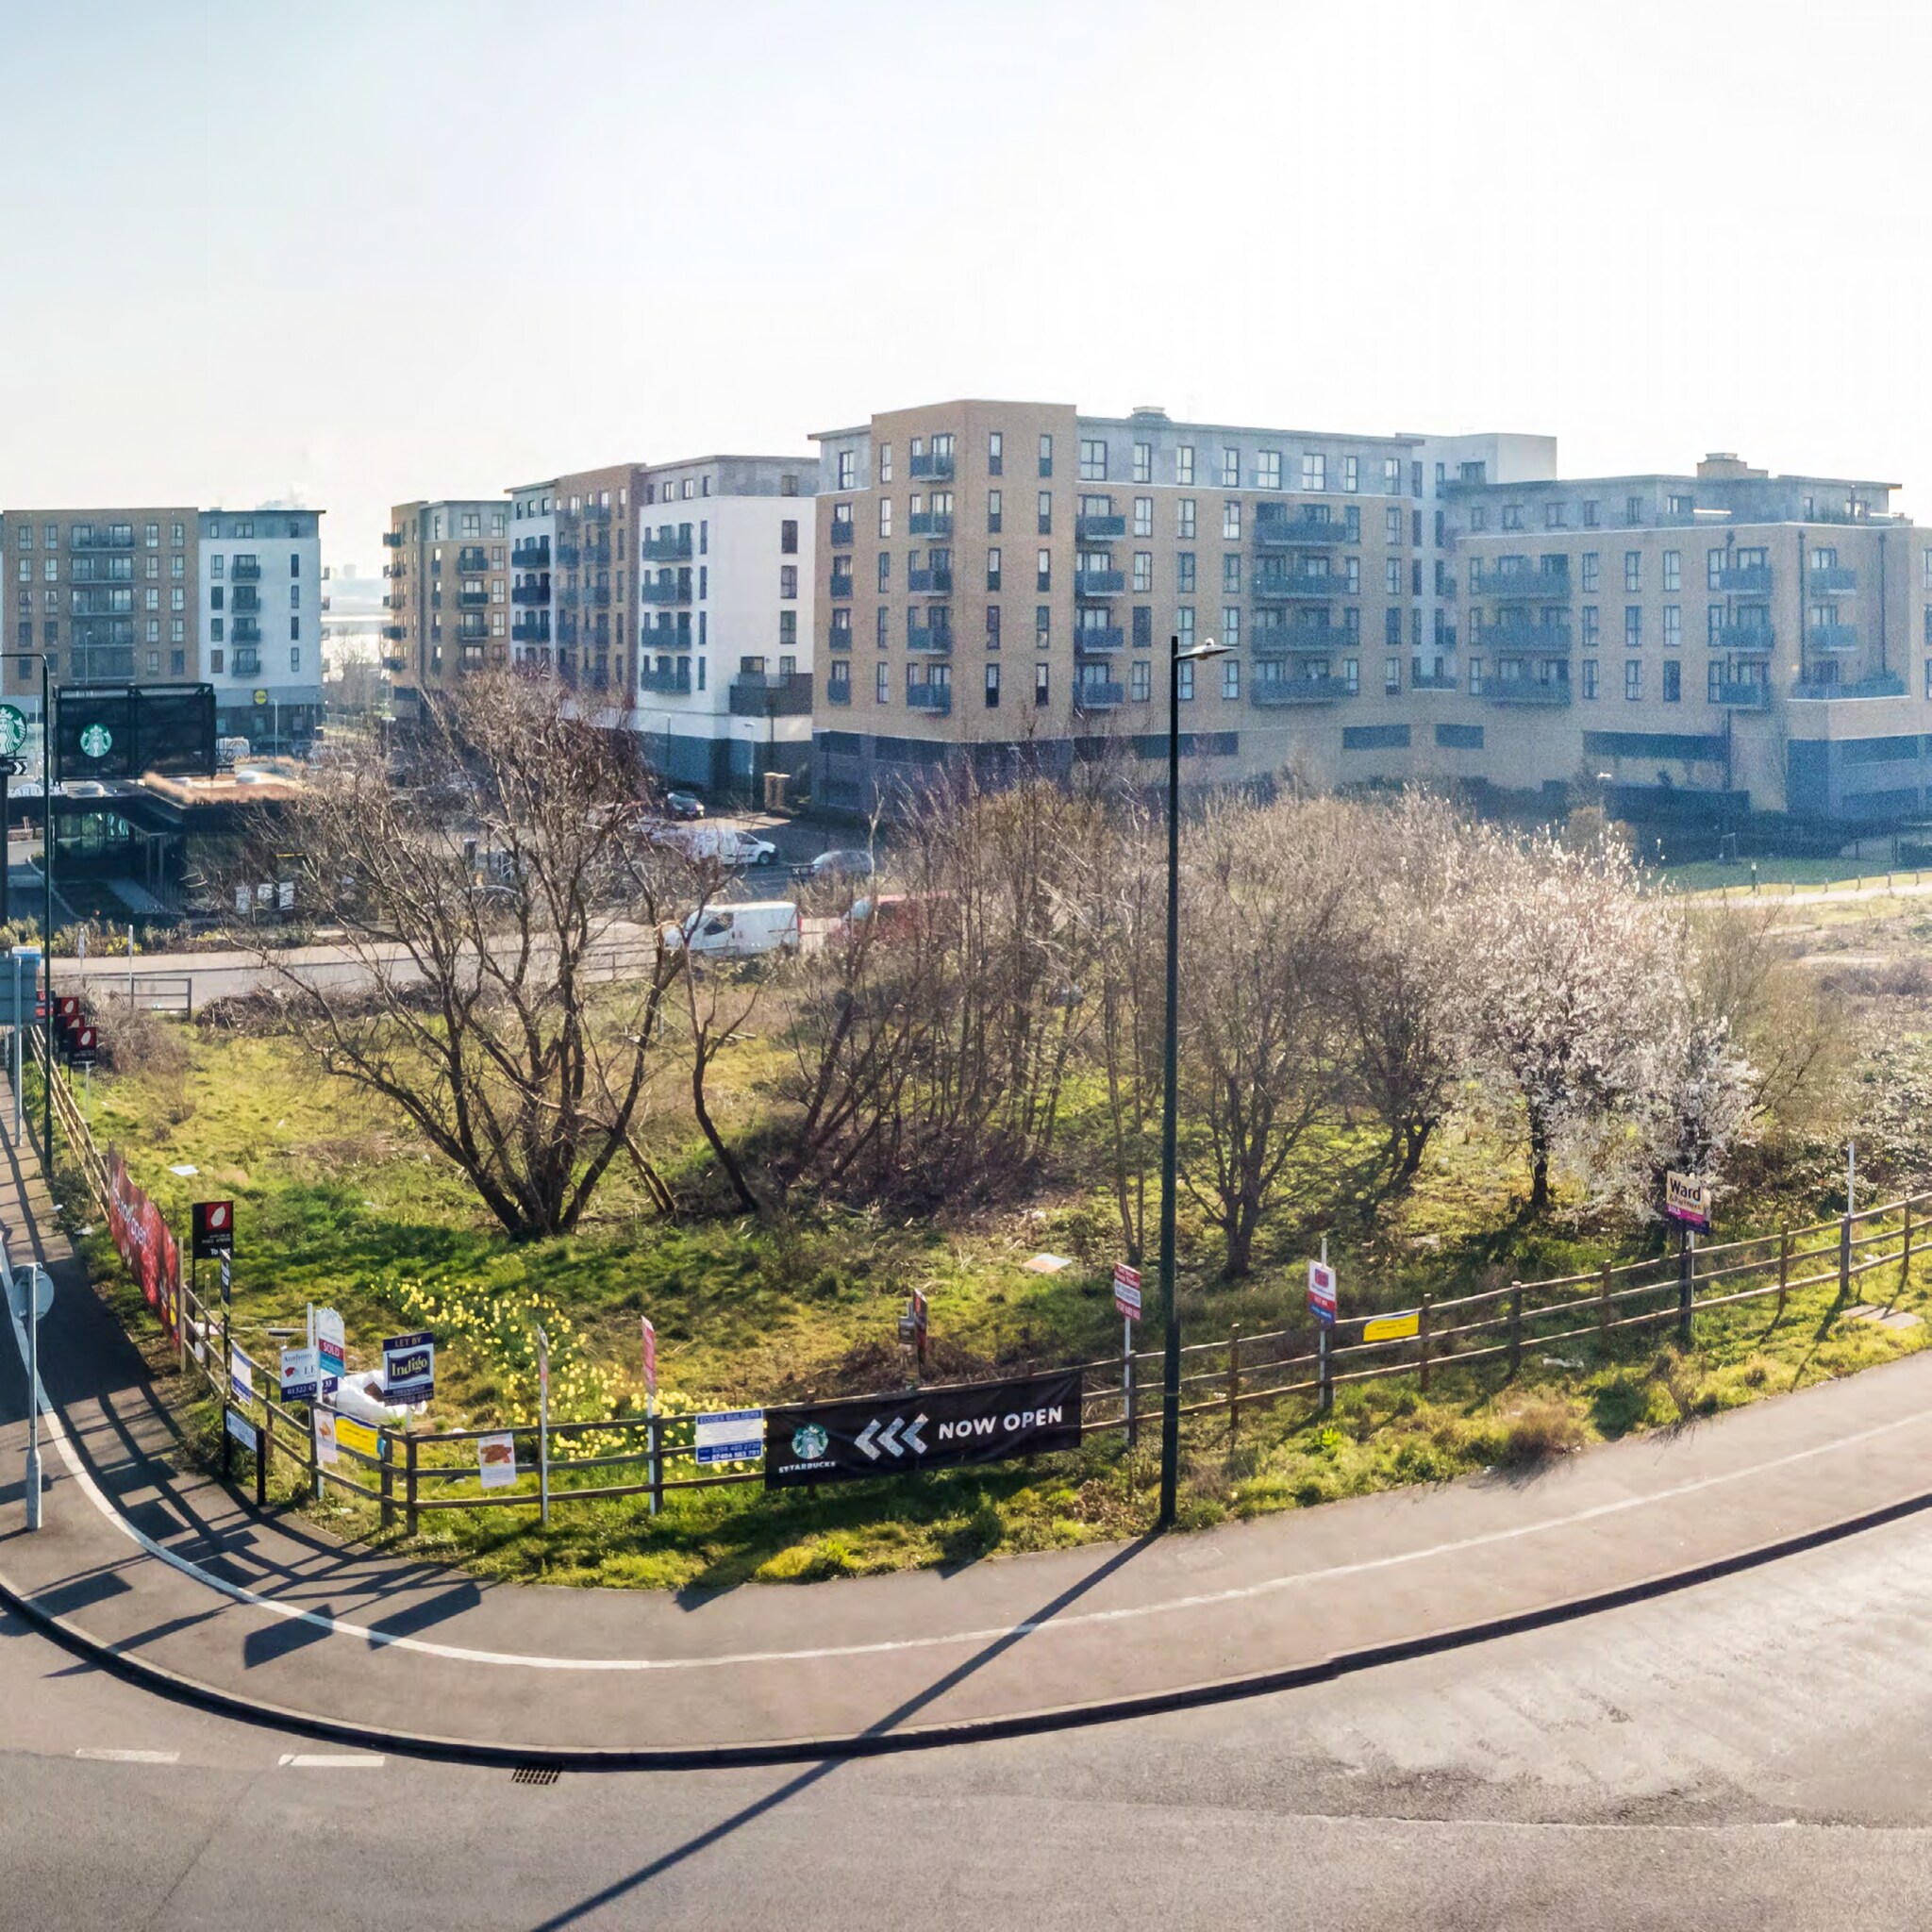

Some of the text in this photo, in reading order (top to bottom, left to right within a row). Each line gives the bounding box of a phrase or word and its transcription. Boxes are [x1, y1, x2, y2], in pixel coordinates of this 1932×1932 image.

[1670, 1176, 1701, 1201] Ward
[209, 1247, 219, 1256] To
[323, 1342, 341, 1357] SOLD
[394, 1336, 422, 1347] LET BY
[391, 1356, 427, 1376] Indigo
[939, 1406, 1062, 1440] NOW OPEN
